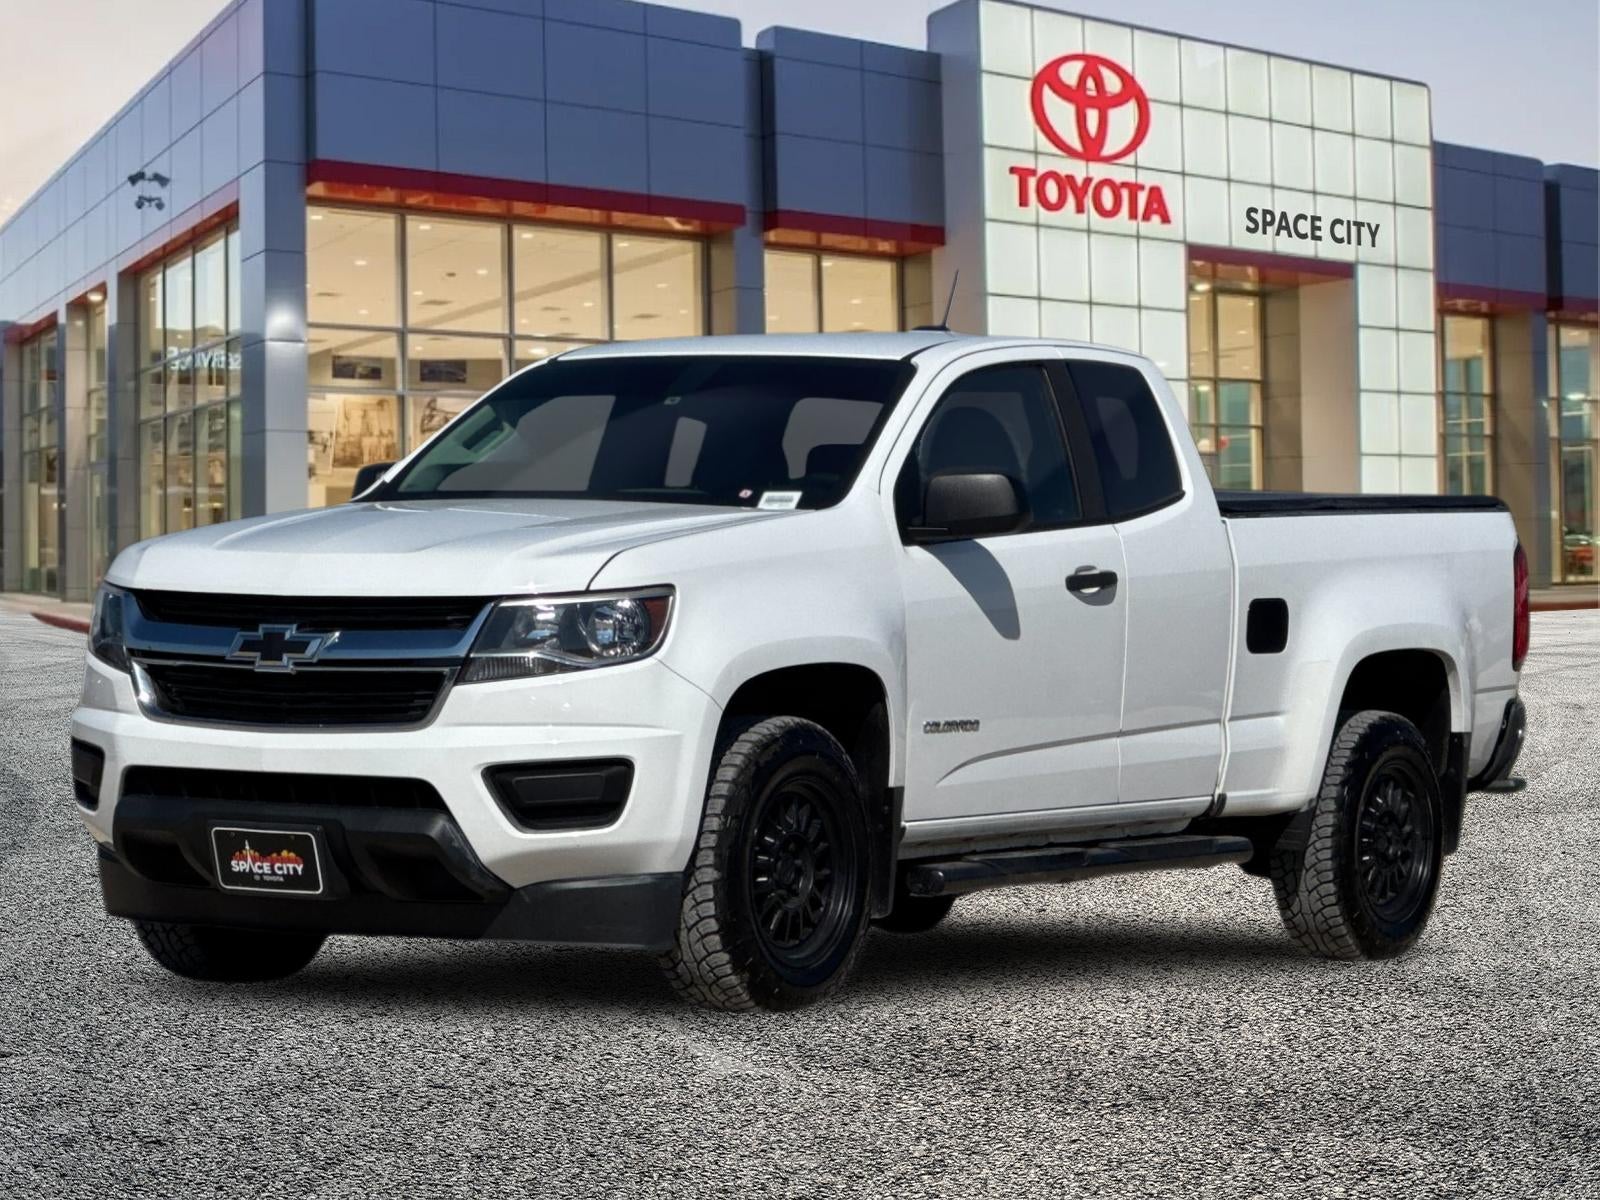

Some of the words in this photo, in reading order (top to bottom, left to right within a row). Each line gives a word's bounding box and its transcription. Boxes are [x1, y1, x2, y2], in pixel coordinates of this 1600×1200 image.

[1009, 166, 1172, 225] TOYOTA
[1245, 207, 1322, 241] SPACE
[1329, 218, 1380, 248] CITY
[923, 719, 980, 734] COLORADO
[231, 860, 271, 874] SPACE
[274, 862, 303, 875] CITY
